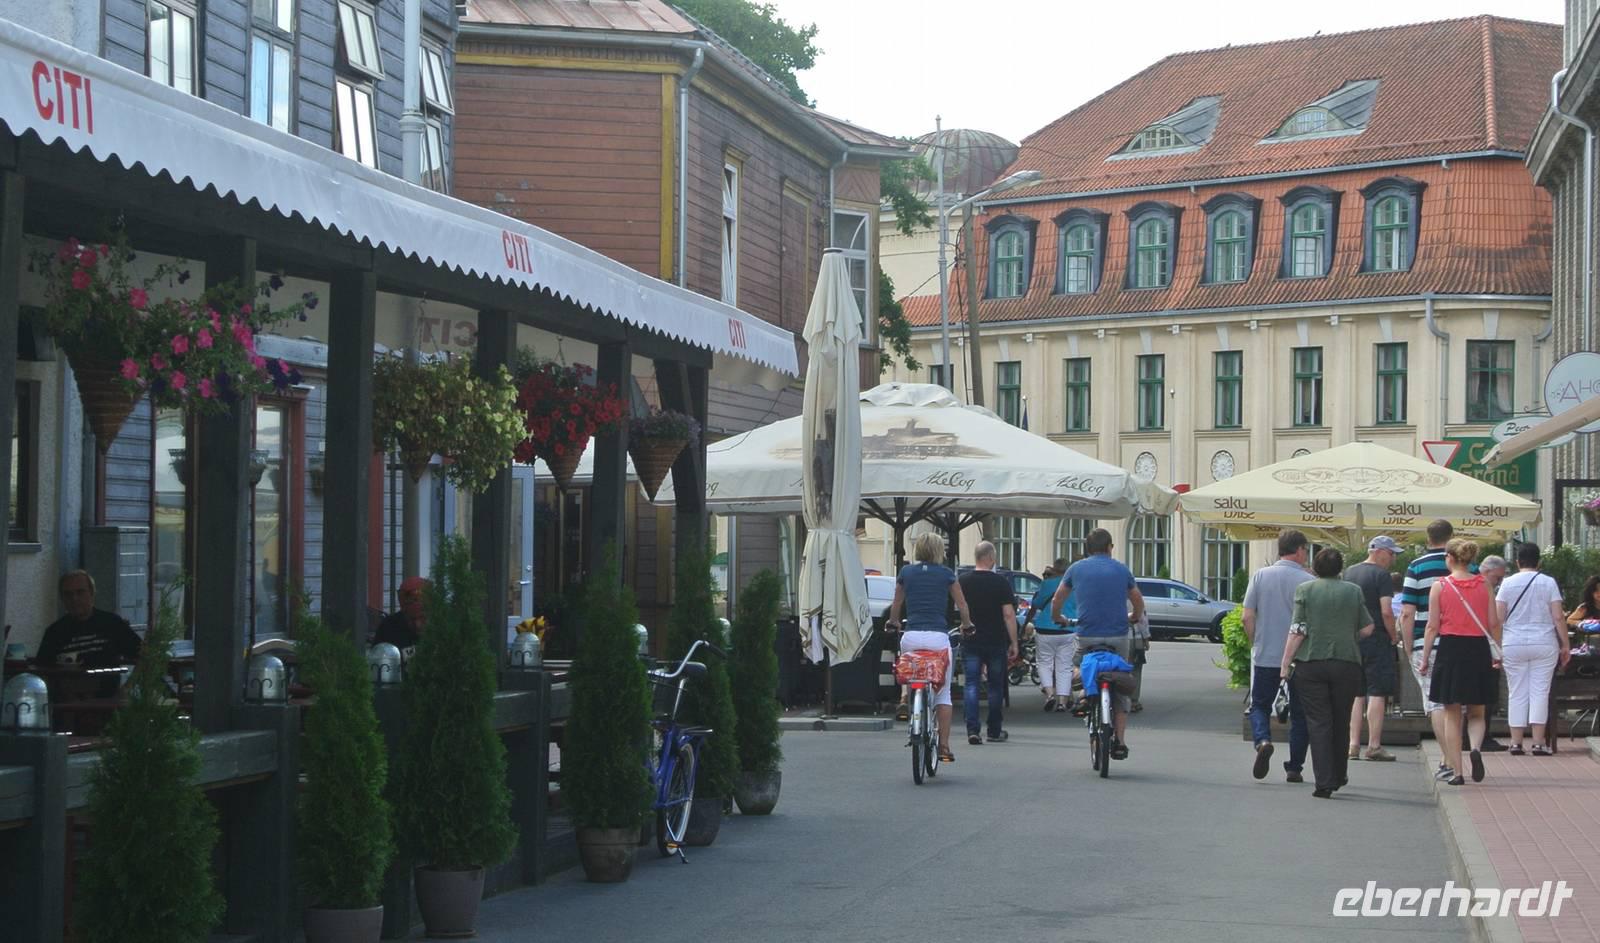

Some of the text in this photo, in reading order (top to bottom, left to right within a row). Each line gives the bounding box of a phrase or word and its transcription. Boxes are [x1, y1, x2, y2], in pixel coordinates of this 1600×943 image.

[32, 60, 94, 135] CITI
[502, 230, 534, 274] CITI
[728, 318, 747, 350] CITI
[1214, 496, 1248, 510] saku
[1300, 500, 1334, 514] saku
[1387, 502, 1422, 516] saku
[1474, 504, 1509, 518] saku
